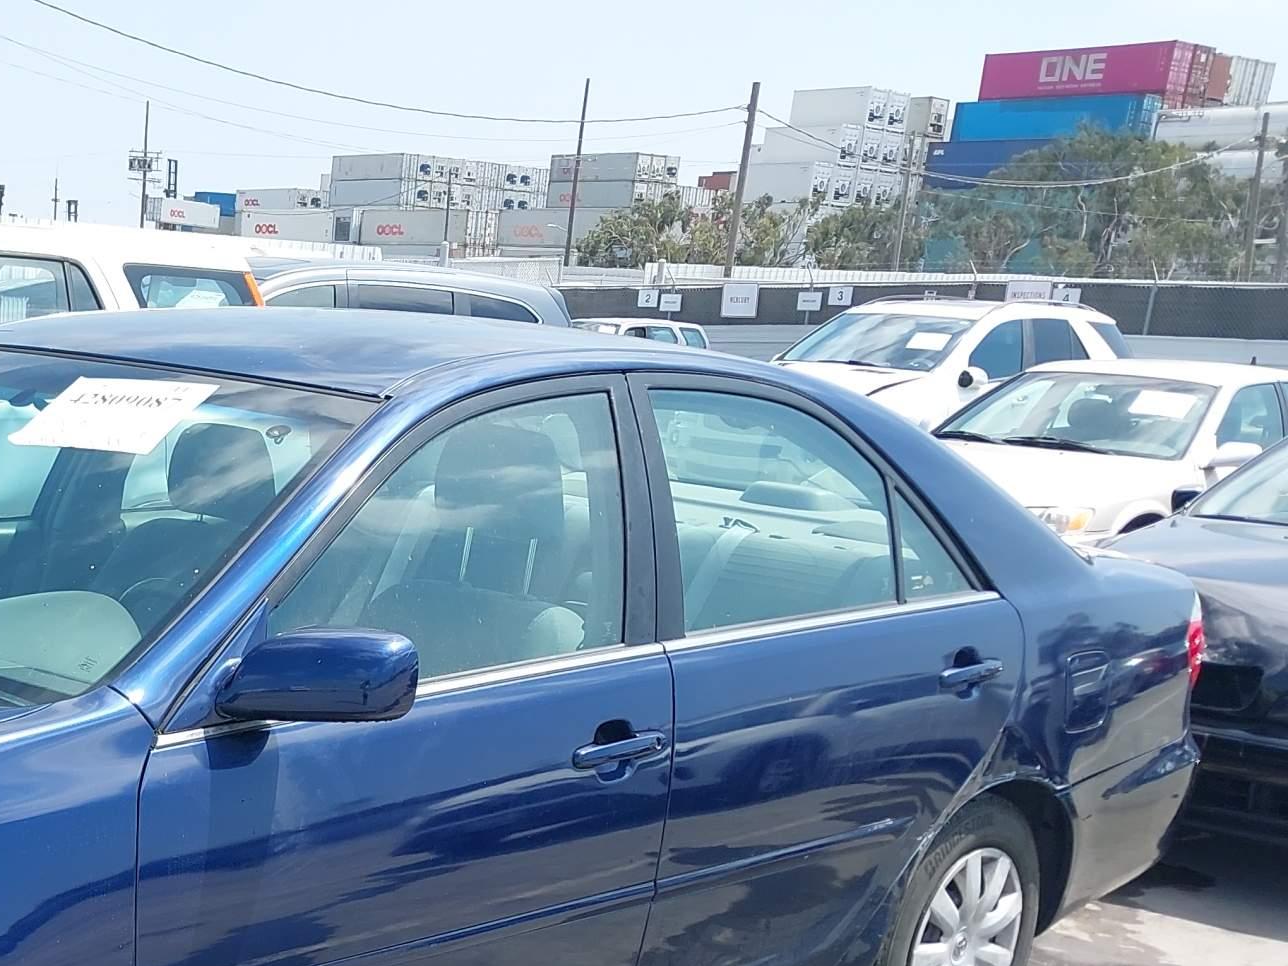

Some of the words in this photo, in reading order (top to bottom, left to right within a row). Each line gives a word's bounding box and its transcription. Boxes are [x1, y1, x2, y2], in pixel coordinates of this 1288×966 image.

[1038, 52, 1108, 83] ONE
[244, 198, 260, 206] OOCL
[169, 208, 186, 219] OOCL
[255, 223, 279, 235] OOCL
[376, 224, 404, 236] OOCL
[645, 294, 652, 304] 2
[837, 291, 844, 301] 3
